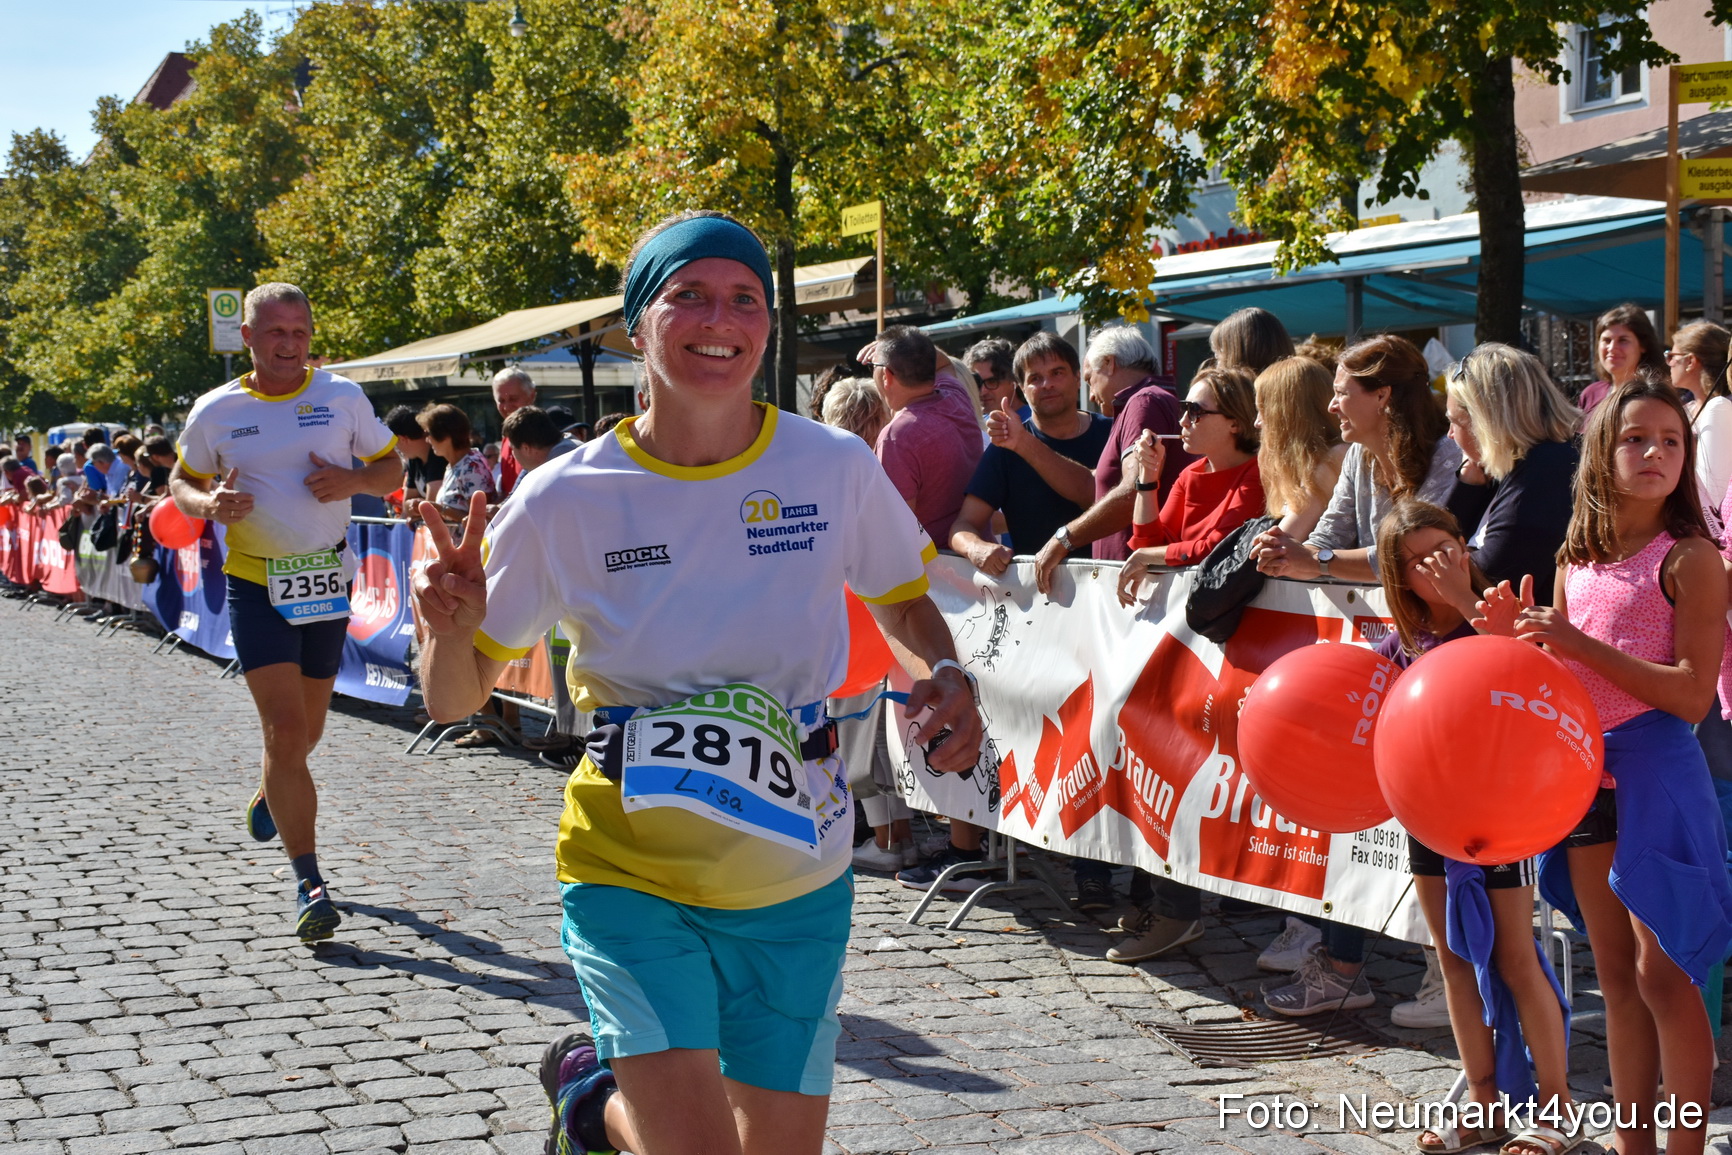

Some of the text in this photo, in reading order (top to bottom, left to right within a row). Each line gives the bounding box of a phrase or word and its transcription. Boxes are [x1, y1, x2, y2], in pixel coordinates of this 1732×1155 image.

[1689, 84, 1728, 99] ausgabe
[849, 212, 879, 227] Toiletten
[1178, 228, 1266, 251] vodafon
[220, 299, 232, 311] H
[297, 404, 313, 415] 20
[745, 498, 815, 523] 20 JAHRE
[746, 521, 829, 539] Neumarkter
[605, 544, 670, 567] BOCK
[749, 537, 815, 556] Stadtlauf
[273, 551, 342, 573] BOCK
[279, 572, 340, 600] 2356
[292, 602, 334, 616] GEORG
[1202, 694, 1215, 733] Seit 1929
[650, 720, 797, 799] 2819
[1556, 730, 1592, 771] energie
[1057, 752, 1096, 812] Braun
[1109, 724, 1175, 822] Braun
[673, 768, 744, 813] Lisa
[1073, 794, 1087, 811] Sicher
[1092, 779, 1105, 793] sicher
[1200, 753, 1320, 839] Bra
[1133, 793, 1171, 842] Sicher ist sicher
[1248, 835, 1330, 867] Sicher ist sicher
[1373, 828, 1400, 849] 09181
[1351, 845, 1370, 865] Fax
[1372, 850, 1399, 871] 09181
